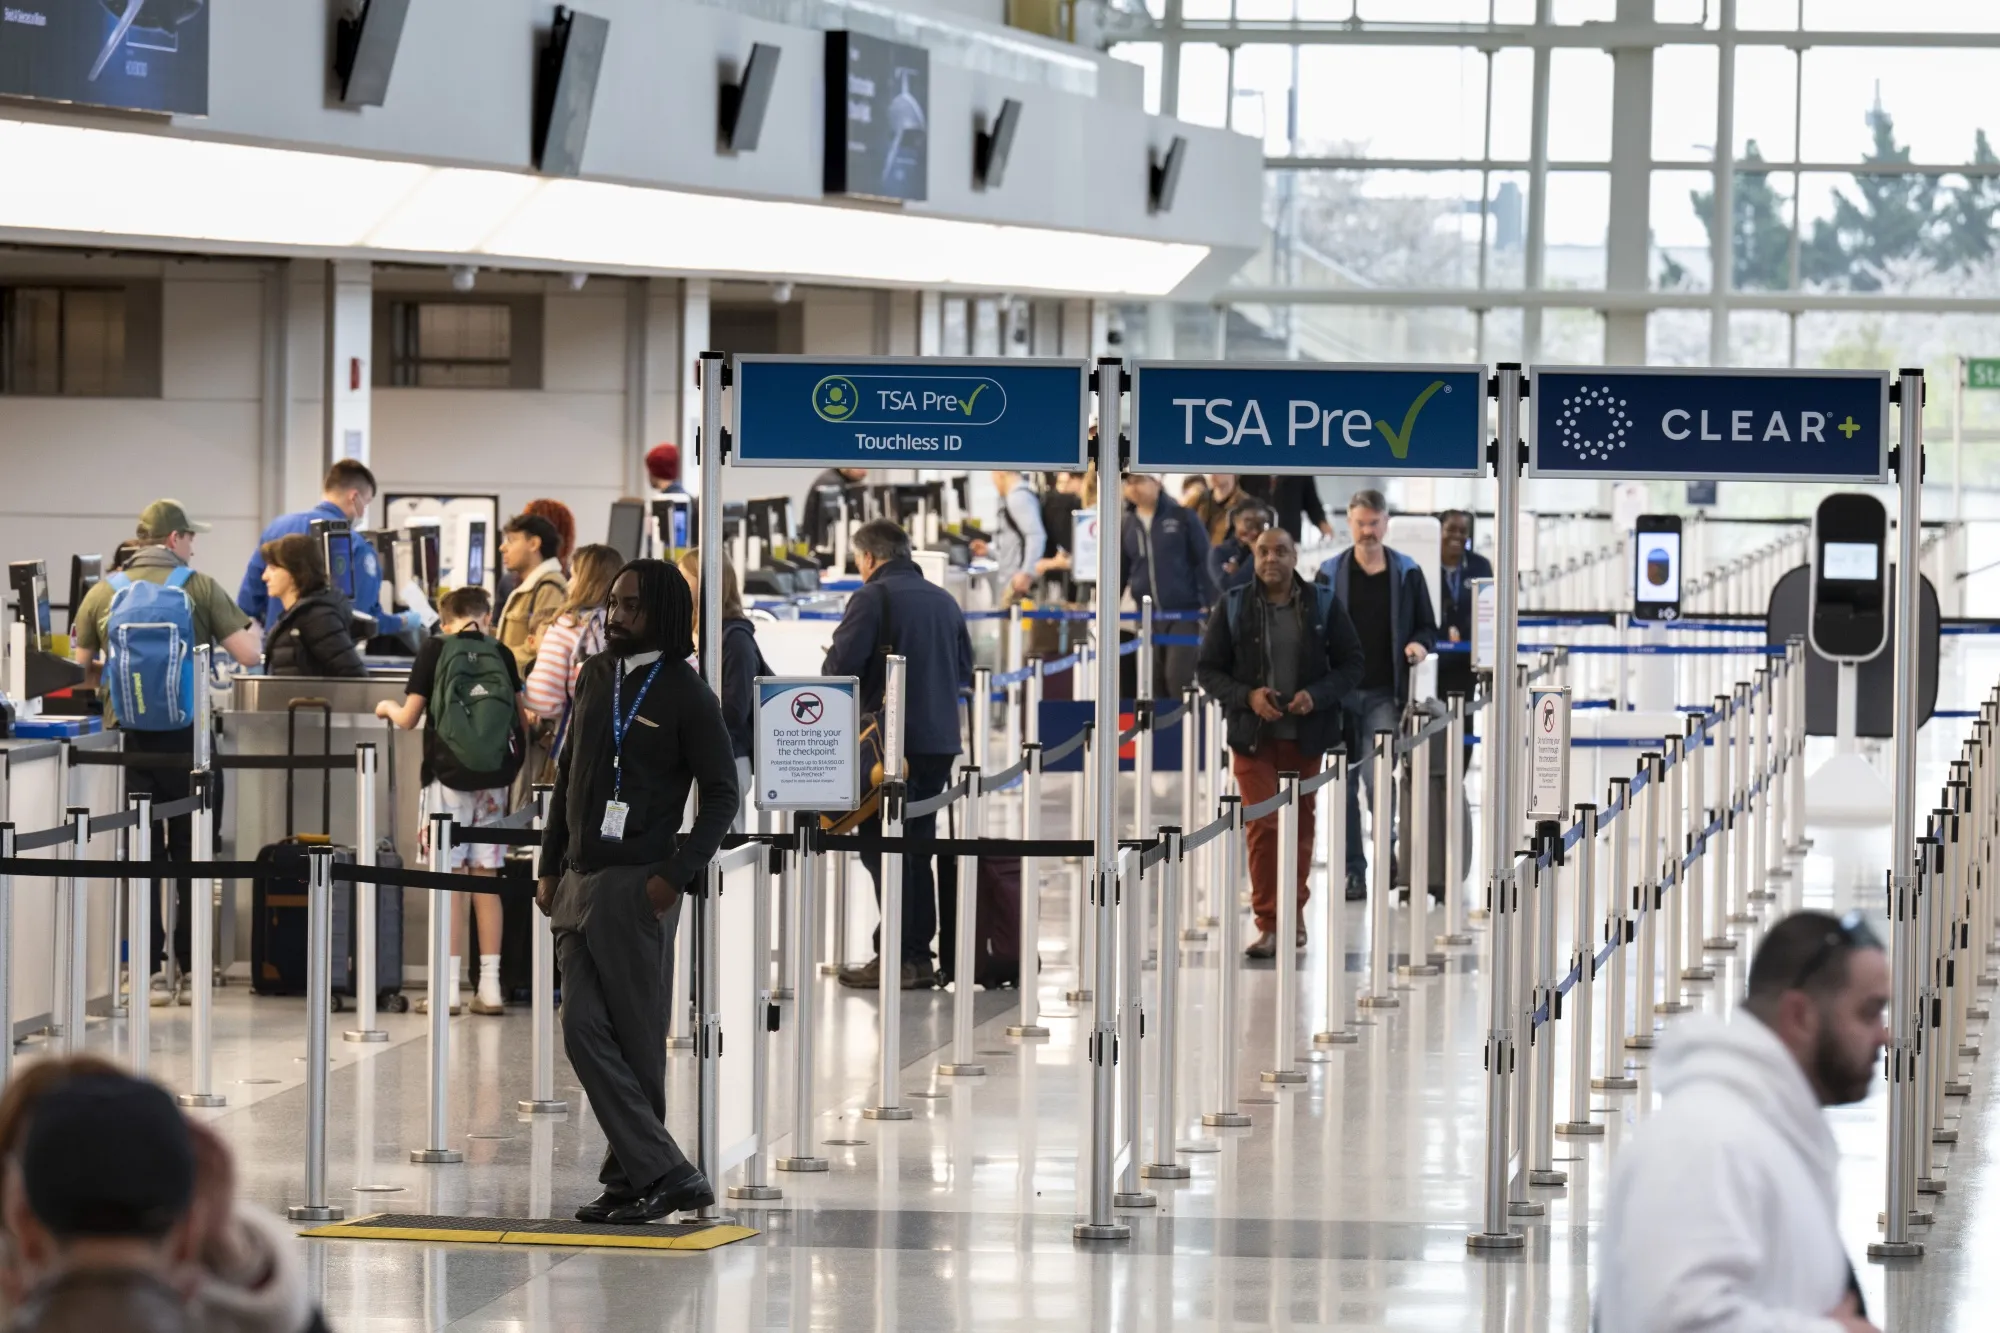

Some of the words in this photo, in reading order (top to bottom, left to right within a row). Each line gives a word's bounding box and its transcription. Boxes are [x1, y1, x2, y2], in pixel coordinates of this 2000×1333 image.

[877, 391, 917, 411] TSA
[1173, 398, 1272, 446] TSA
[855, 434, 939, 450] Touchless
[944, 435, 962, 450] ID
[773, 729, 785, 737] Do
[786, 729, 799, 737] not
[801, 728, 821, 738] bring
[823, 729, 842, 738] your
[776, 738, 806, 746] firearm
[807, 738, 839, 747] through
[778, 748, 791, 756] the
[792, 747, 837, 756] checkpoint.
